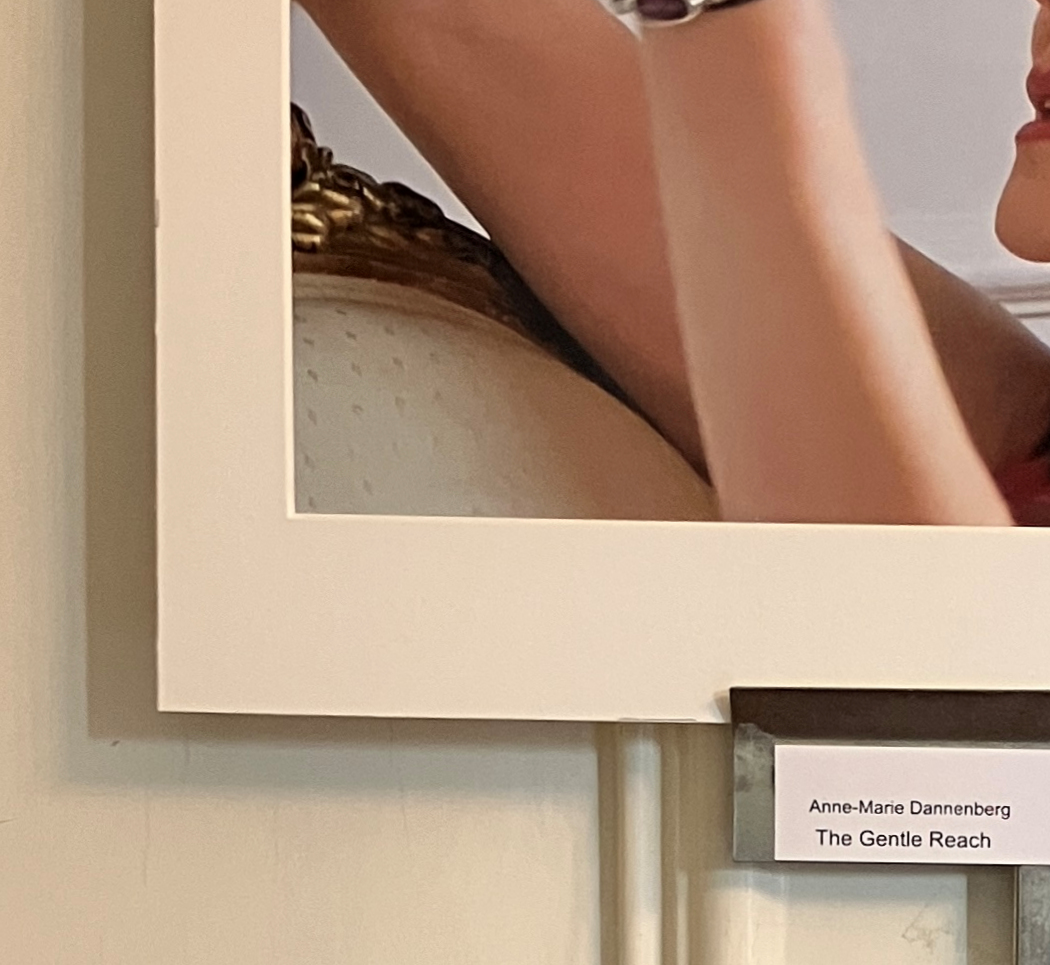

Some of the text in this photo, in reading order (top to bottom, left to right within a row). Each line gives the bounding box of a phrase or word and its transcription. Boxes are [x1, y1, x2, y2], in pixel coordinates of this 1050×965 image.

[809, 799, 1011, 819] Anne-Marie Dannenberg
[815, 828, 992, 848] The Gentle Reach
